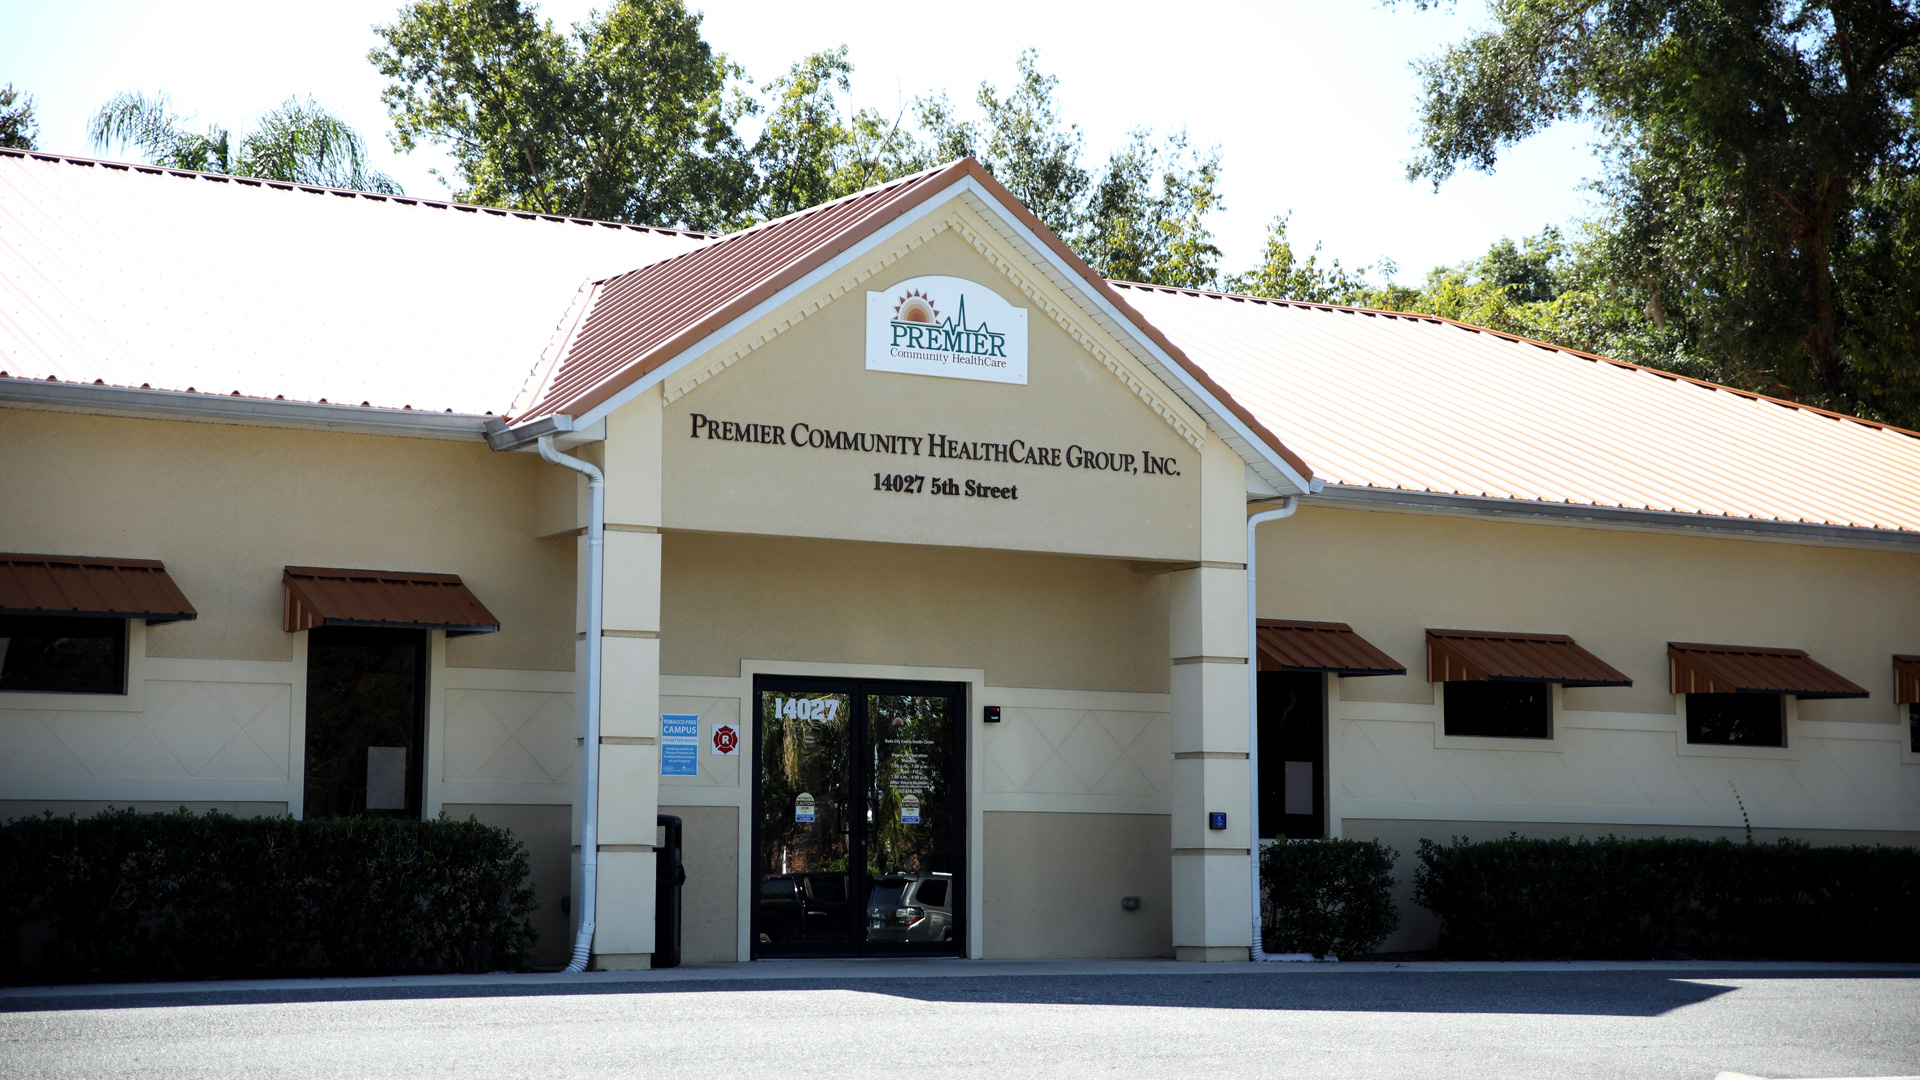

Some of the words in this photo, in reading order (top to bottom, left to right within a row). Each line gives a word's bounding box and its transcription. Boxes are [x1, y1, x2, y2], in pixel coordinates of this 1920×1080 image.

[890, 324, 1007, 357] PREMIER
[890, 348, 949, 364] Community
[952, 354, 1007, 368] HealthCare
[873, 472, 925, 494] 14027
[930, 477, 960, 496] 5th
[964, 479, 1018, 500] Street
[775, 697, 839, 721] 14027
[663, 725, 697, 734] CAMPUS
[722, 735, 730, 745] R
